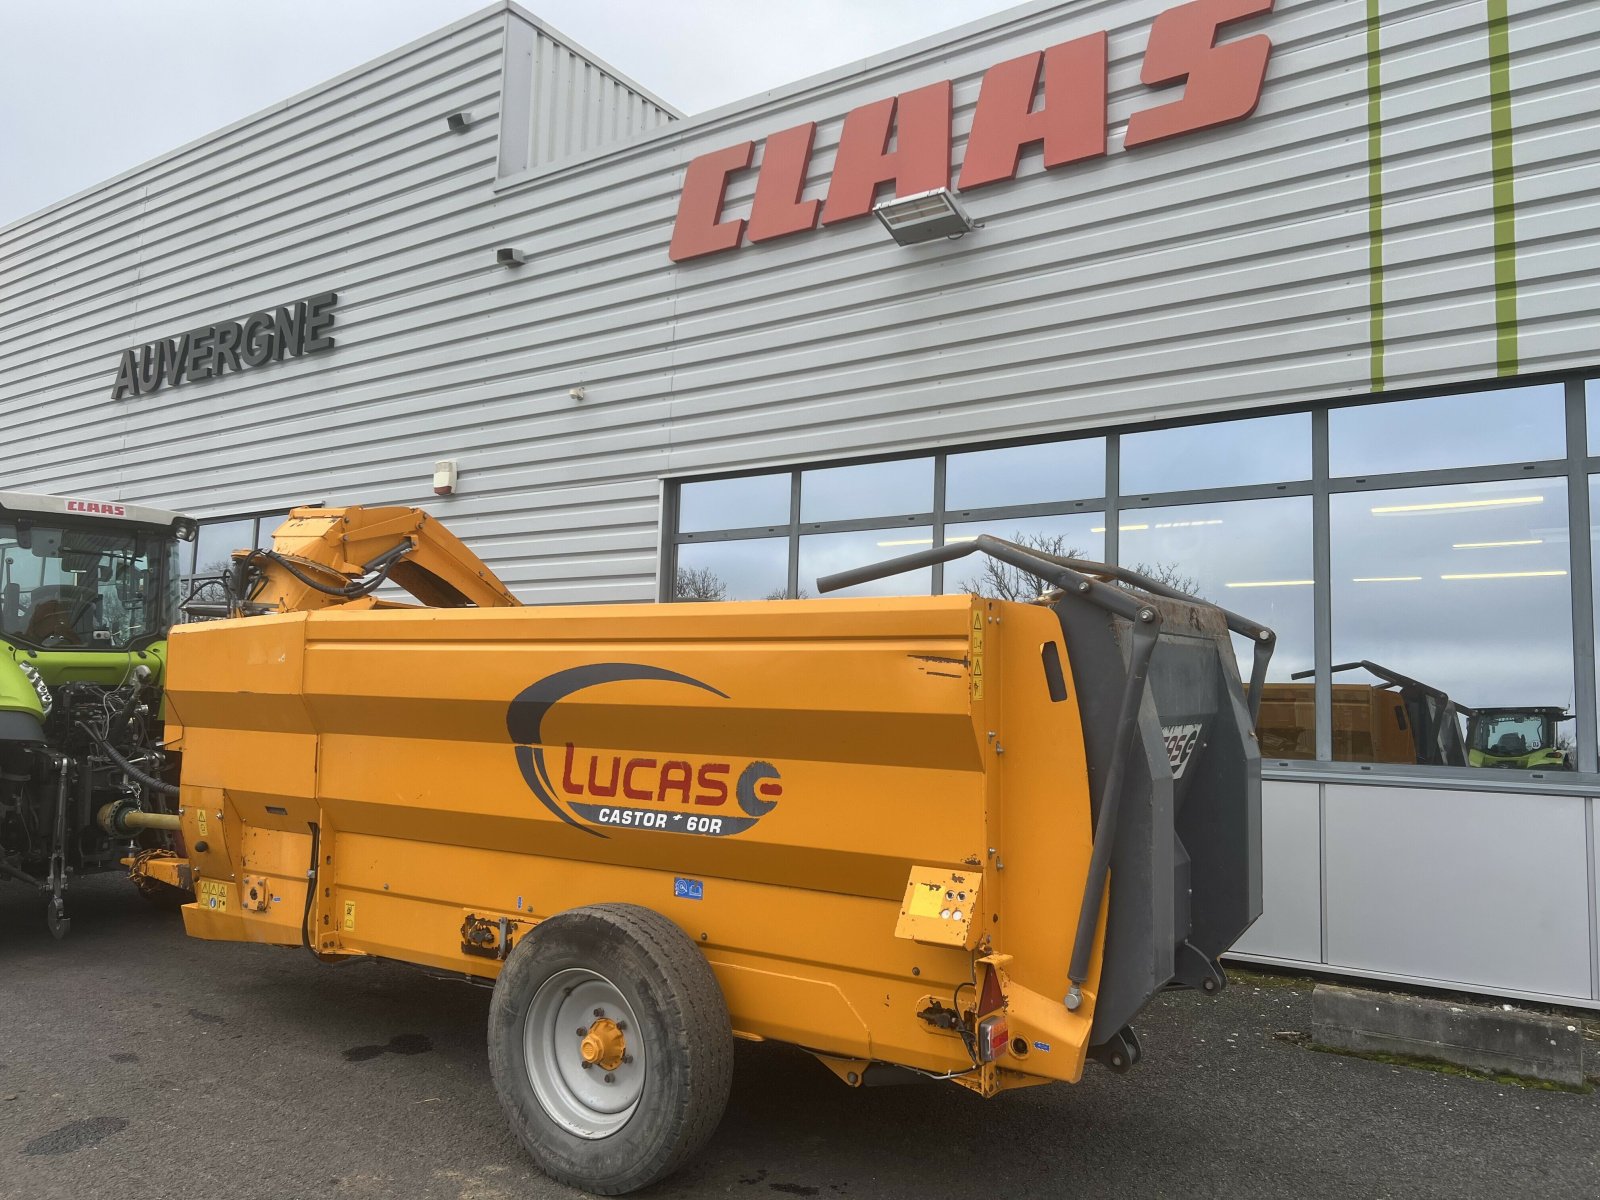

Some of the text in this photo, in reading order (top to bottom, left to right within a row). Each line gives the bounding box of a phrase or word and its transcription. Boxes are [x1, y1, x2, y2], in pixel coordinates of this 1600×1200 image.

[668, 0, 1274, 262] CLAAS
[111, 292, 338, 400] AUVERGNE
[67, 501, 125, 516] CLAAS
[562, 742, 730, 807] LUCAS
[598, 807, 668, 829] CASTOR
[686, 815, 723, 834] 60R
